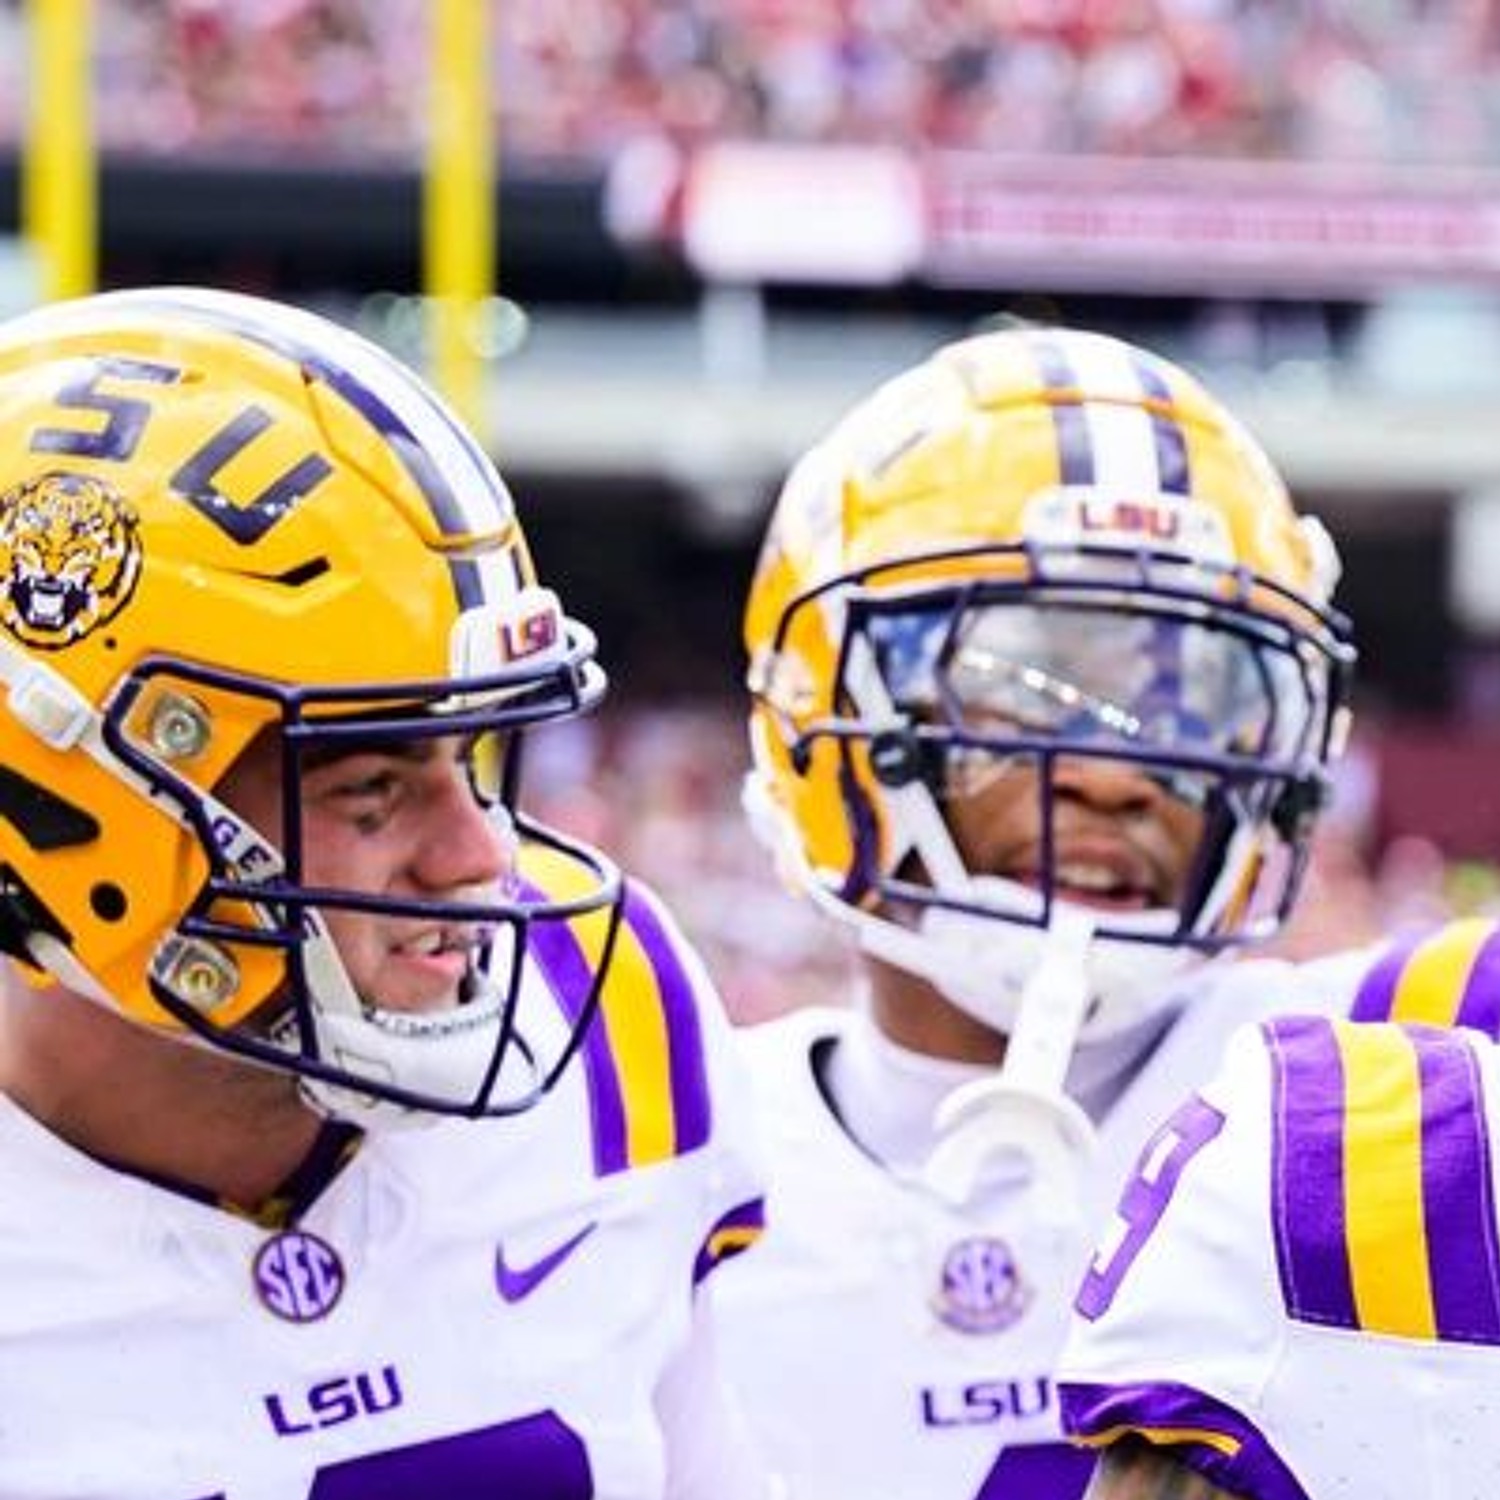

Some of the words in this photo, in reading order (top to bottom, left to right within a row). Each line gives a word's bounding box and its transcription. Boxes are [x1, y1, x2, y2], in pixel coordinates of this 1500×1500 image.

[1078, 501, 1180, 539] LSU
[259, 1234, 341, 1319] SEC
[263, 1366, 402, 1436] LSU
[921, 1376, 1049, 1427] LSU
